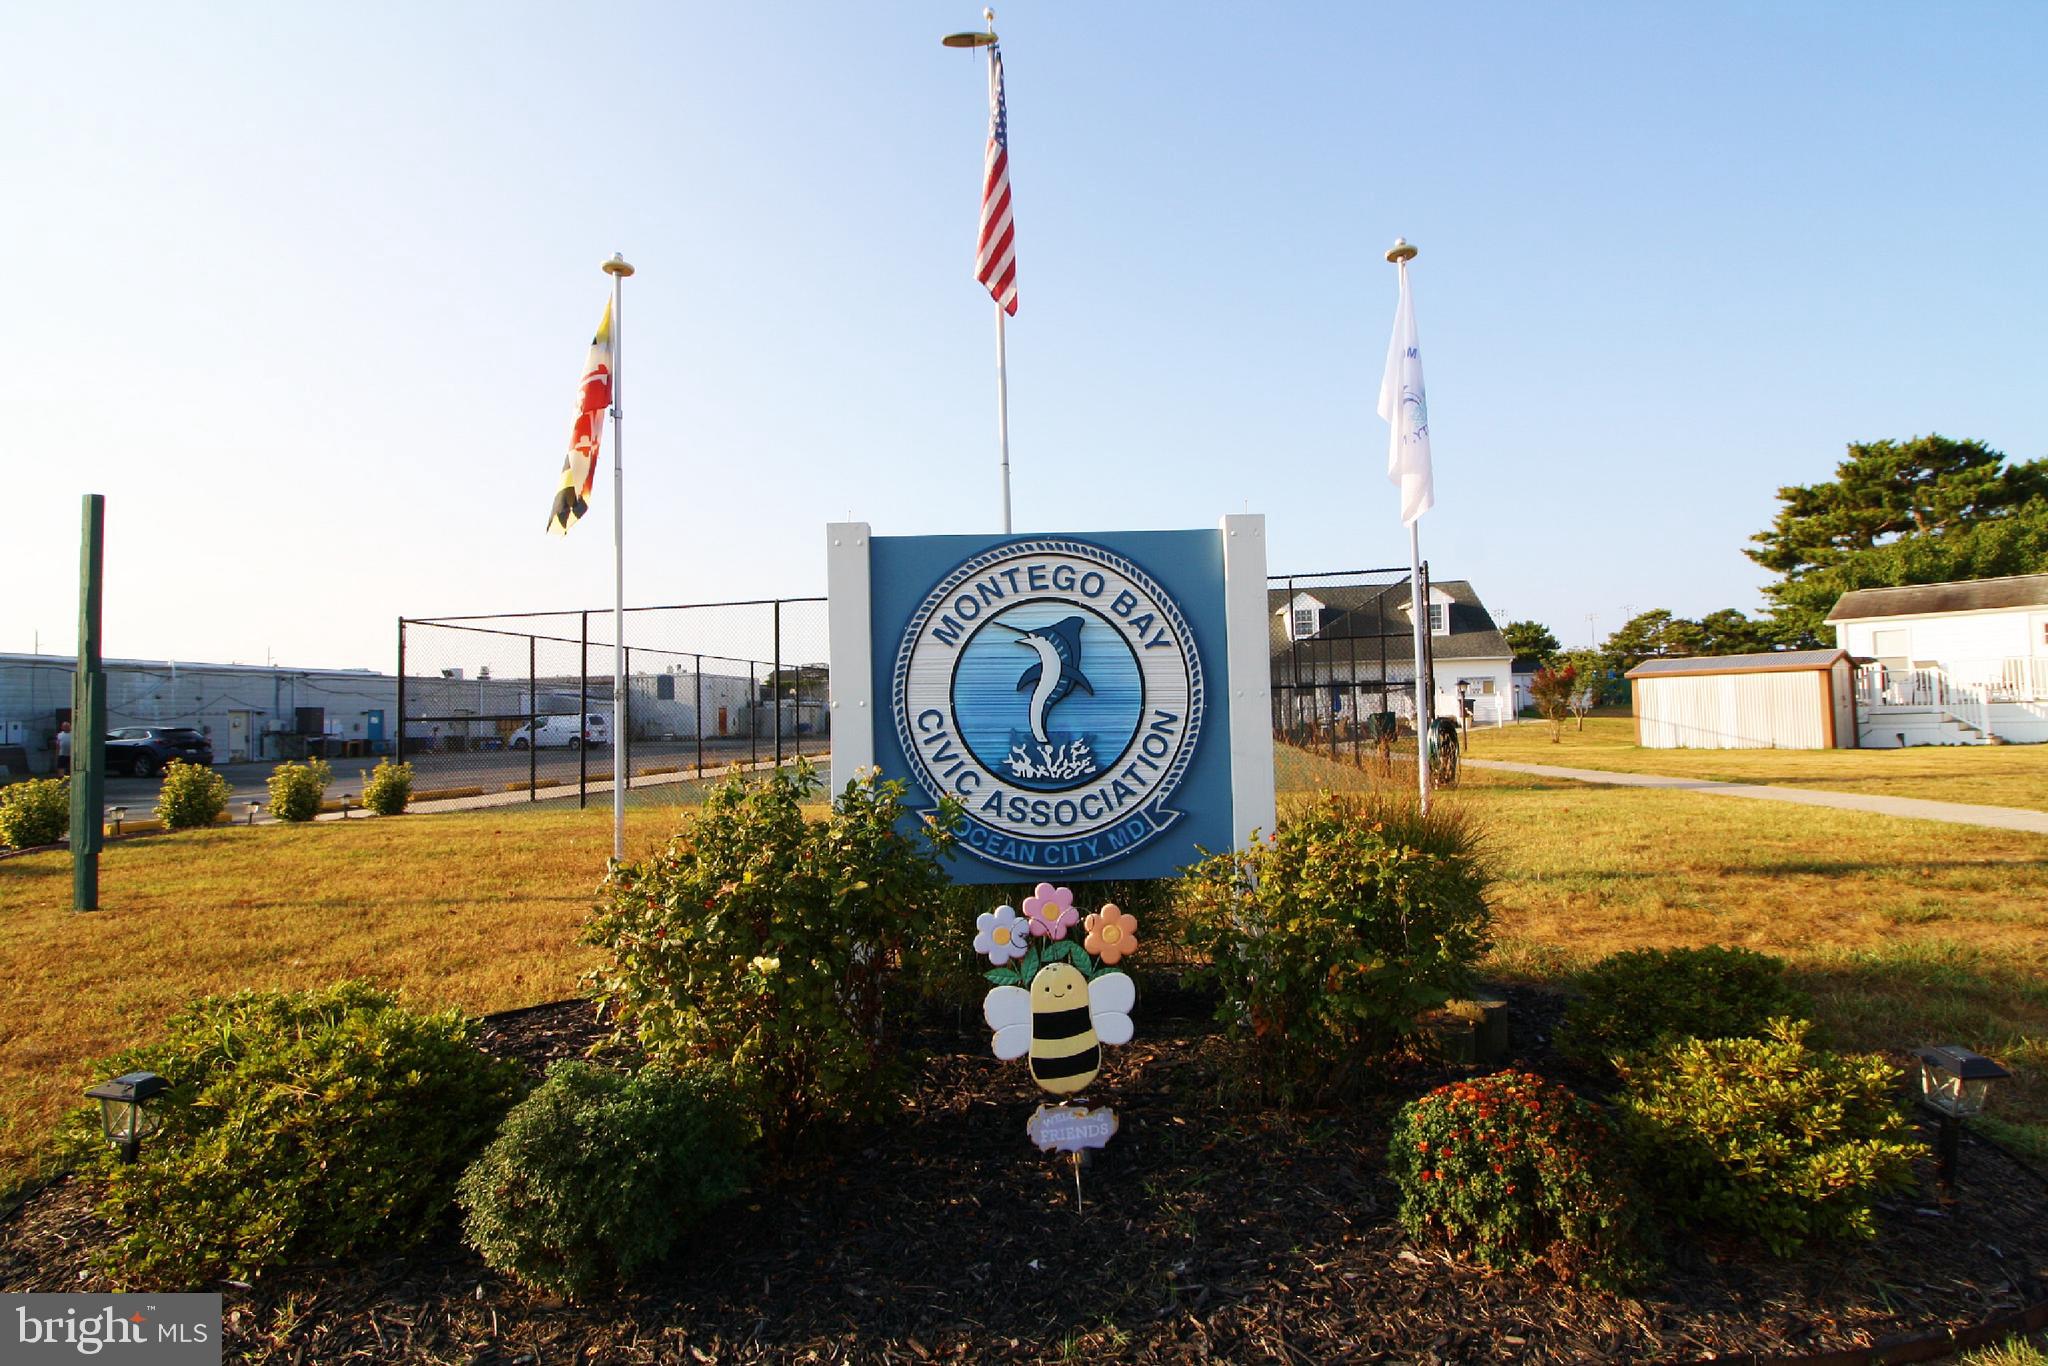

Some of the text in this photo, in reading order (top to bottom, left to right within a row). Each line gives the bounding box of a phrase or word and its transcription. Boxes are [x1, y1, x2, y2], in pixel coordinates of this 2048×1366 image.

[931, 564, 1172, 650] MONTEGO BAY
[917, 709, 1178, 827] CIVIC ASSOCIATION
[952, 818, 1036, 864] OCEAN
[1040, 1122, 1109, 1143] FRIENDS
